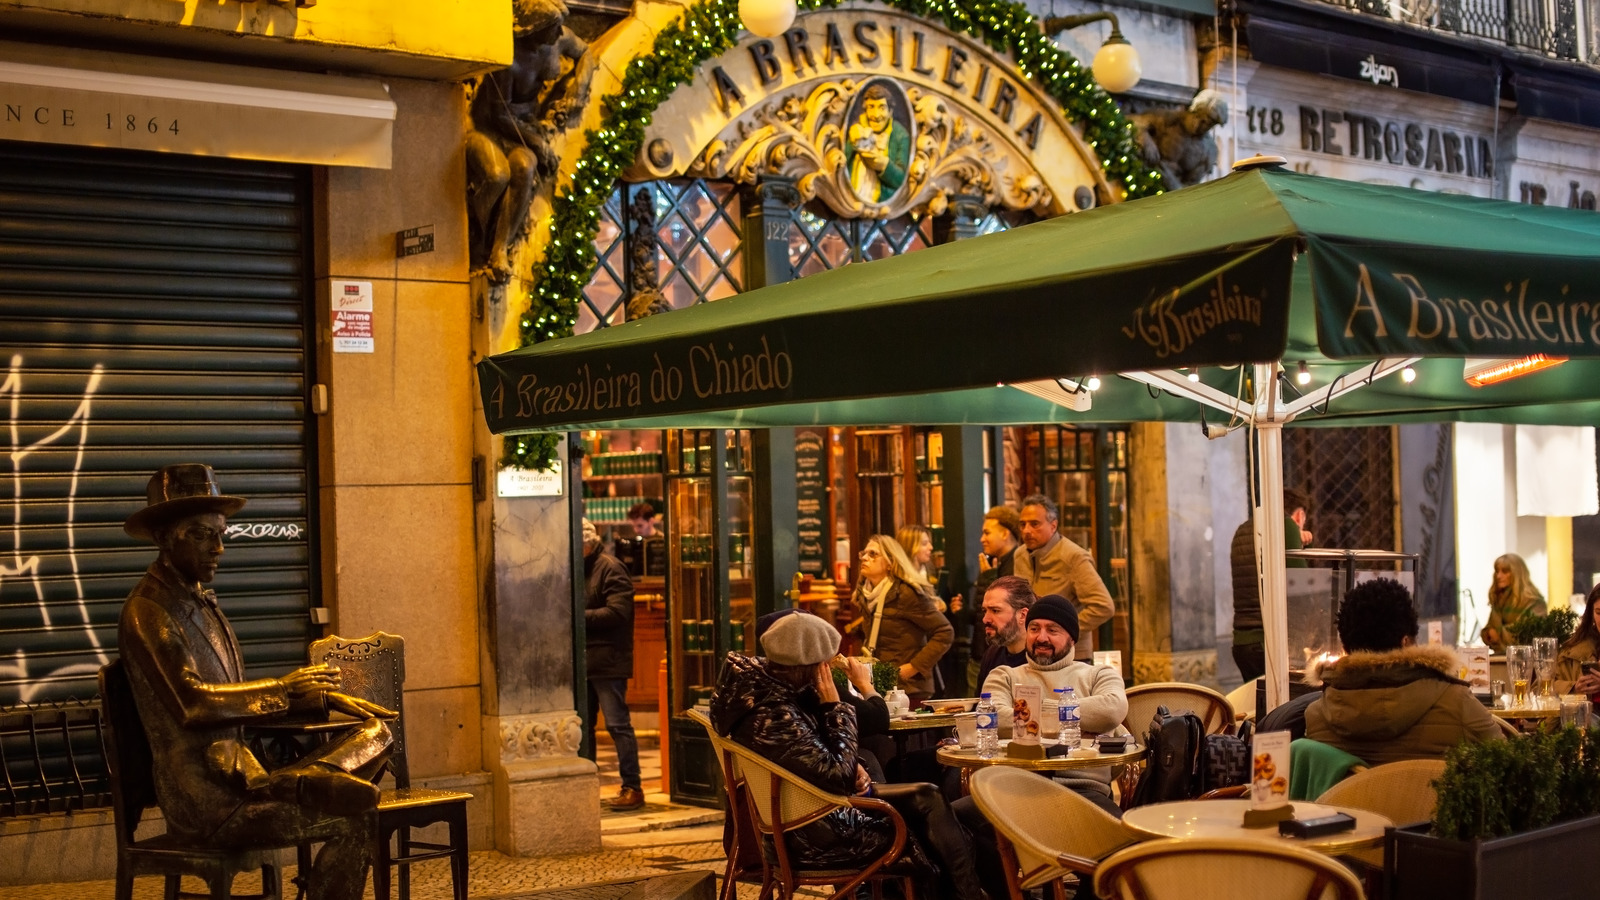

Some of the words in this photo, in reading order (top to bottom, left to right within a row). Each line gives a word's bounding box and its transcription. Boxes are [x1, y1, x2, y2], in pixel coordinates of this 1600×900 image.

[712, 66, 746, 115] A
[747, 21, 1042, 150] BRASILEIRA
[1360, 54, 1399, 88] zilian
[5, 104, 76, 127] NCE
[106, 113, 179, 135] 1864
[1246, 106, 1284, 135] 118
[1299, 105, 1494, 178] RETROSARIA
[767, 221, 789, 241] 122
[336, 311, 370, 321] Alarme
[1151, 273, 1262, 358] Brasileira
[1344, 263, 1388, 338] A
[490, 375, 505, 420] A
[515, 362, 641, 418] Brasileira
[650, 352, 683, 404] do
[689, 334, 793, 399] Chiado
